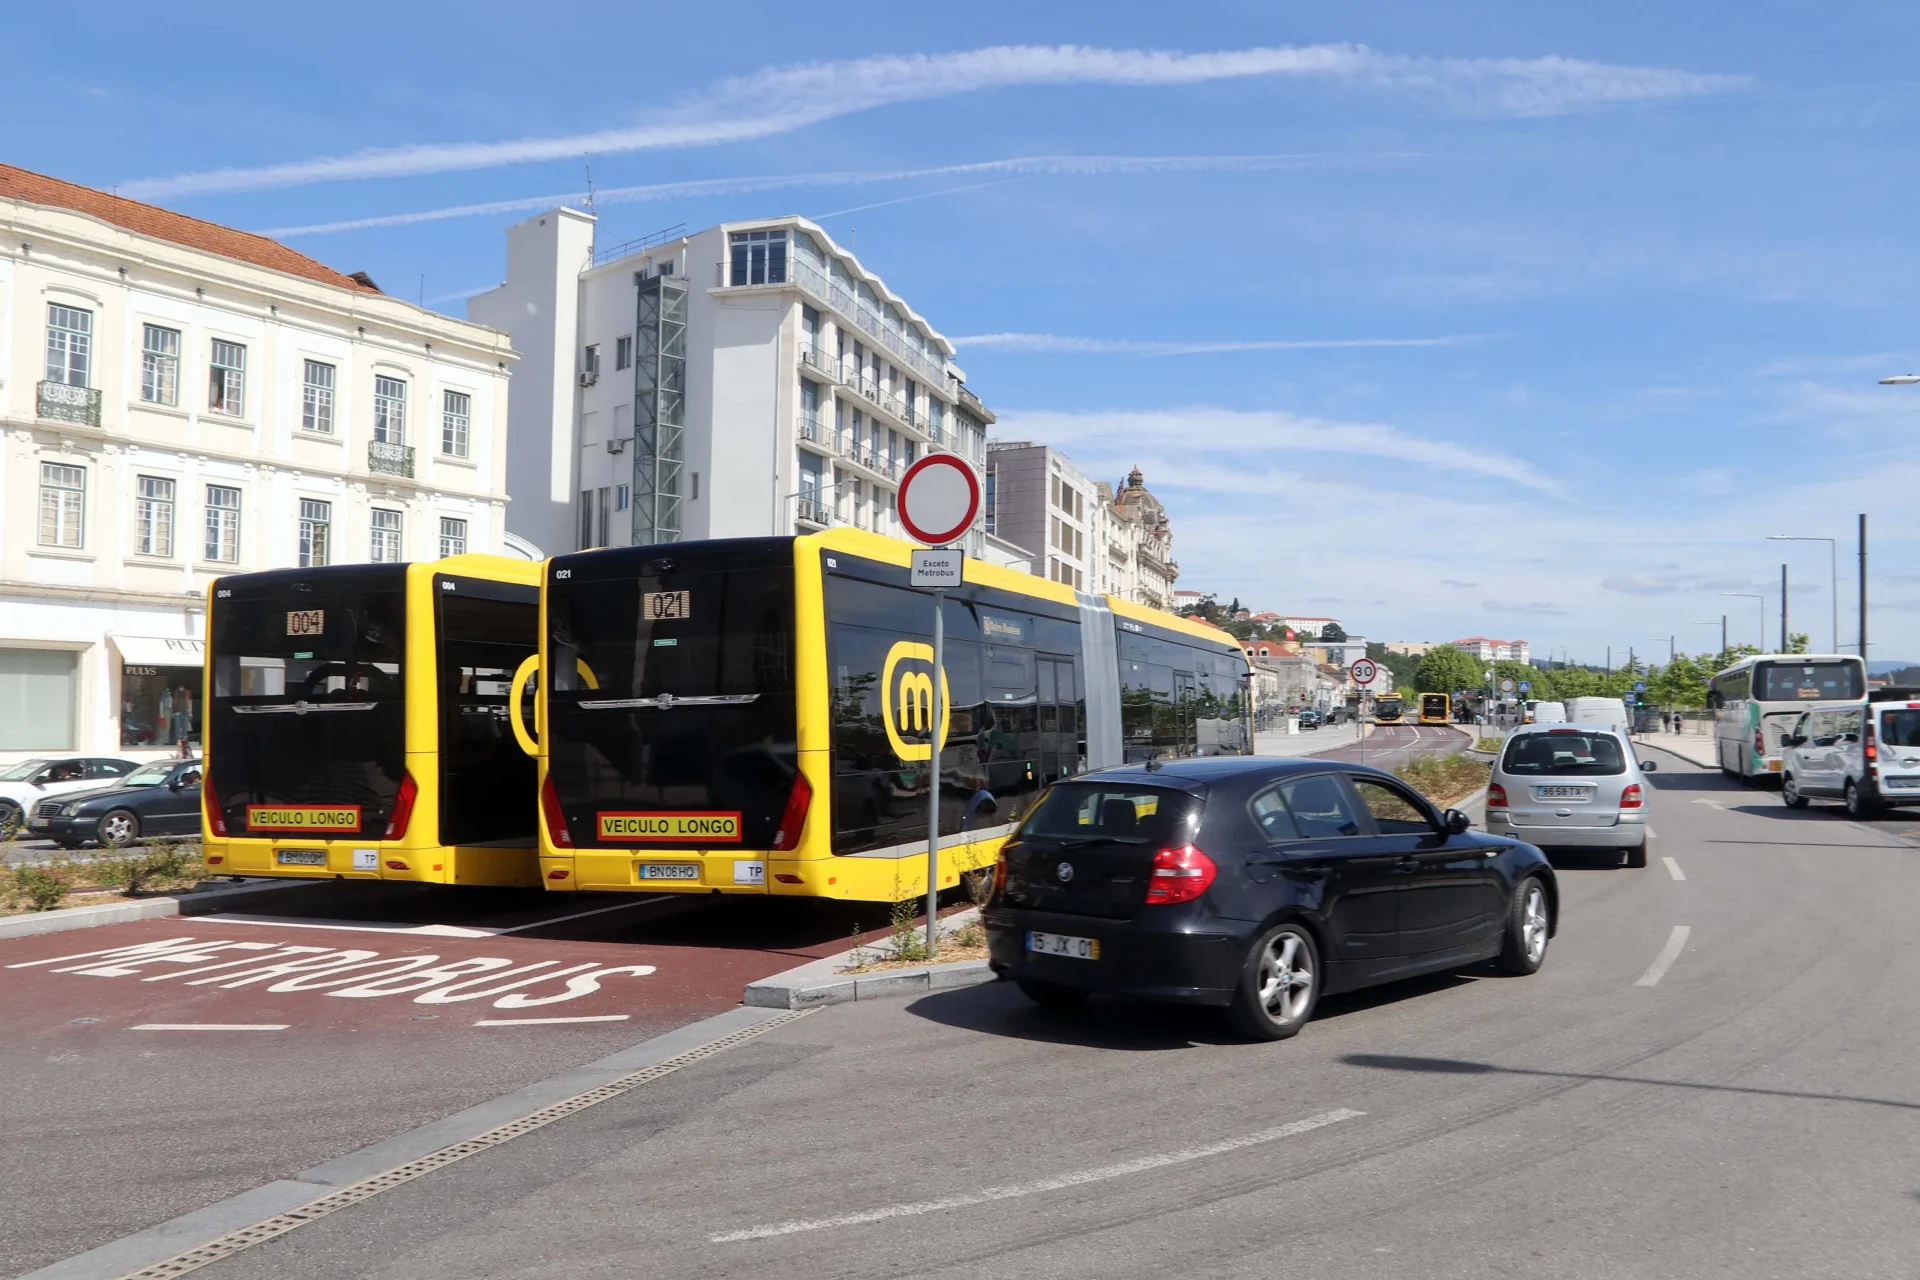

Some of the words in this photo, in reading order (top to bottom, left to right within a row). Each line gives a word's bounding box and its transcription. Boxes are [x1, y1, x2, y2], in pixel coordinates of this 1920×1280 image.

[556, 570, 571, 579] 021
[442, 581, 455, 591] 004
[217, 590, 231, 598] 004
[653, 592, 682, 618] 021
[292, 611, 320, 633] 004
[1355, 666, 1372, 677] 30
[252, 811, 303, 824] VEICULO
[310, 812, 355, 825] LONGO
[604, 819, 669, 833] VEICULO
[678, 820, 735, 833] LONGO
[365, 854, 376, 864] TP
[748, 866, 763, 877] TP
[4, 937, 656, 1008] METROBUS
